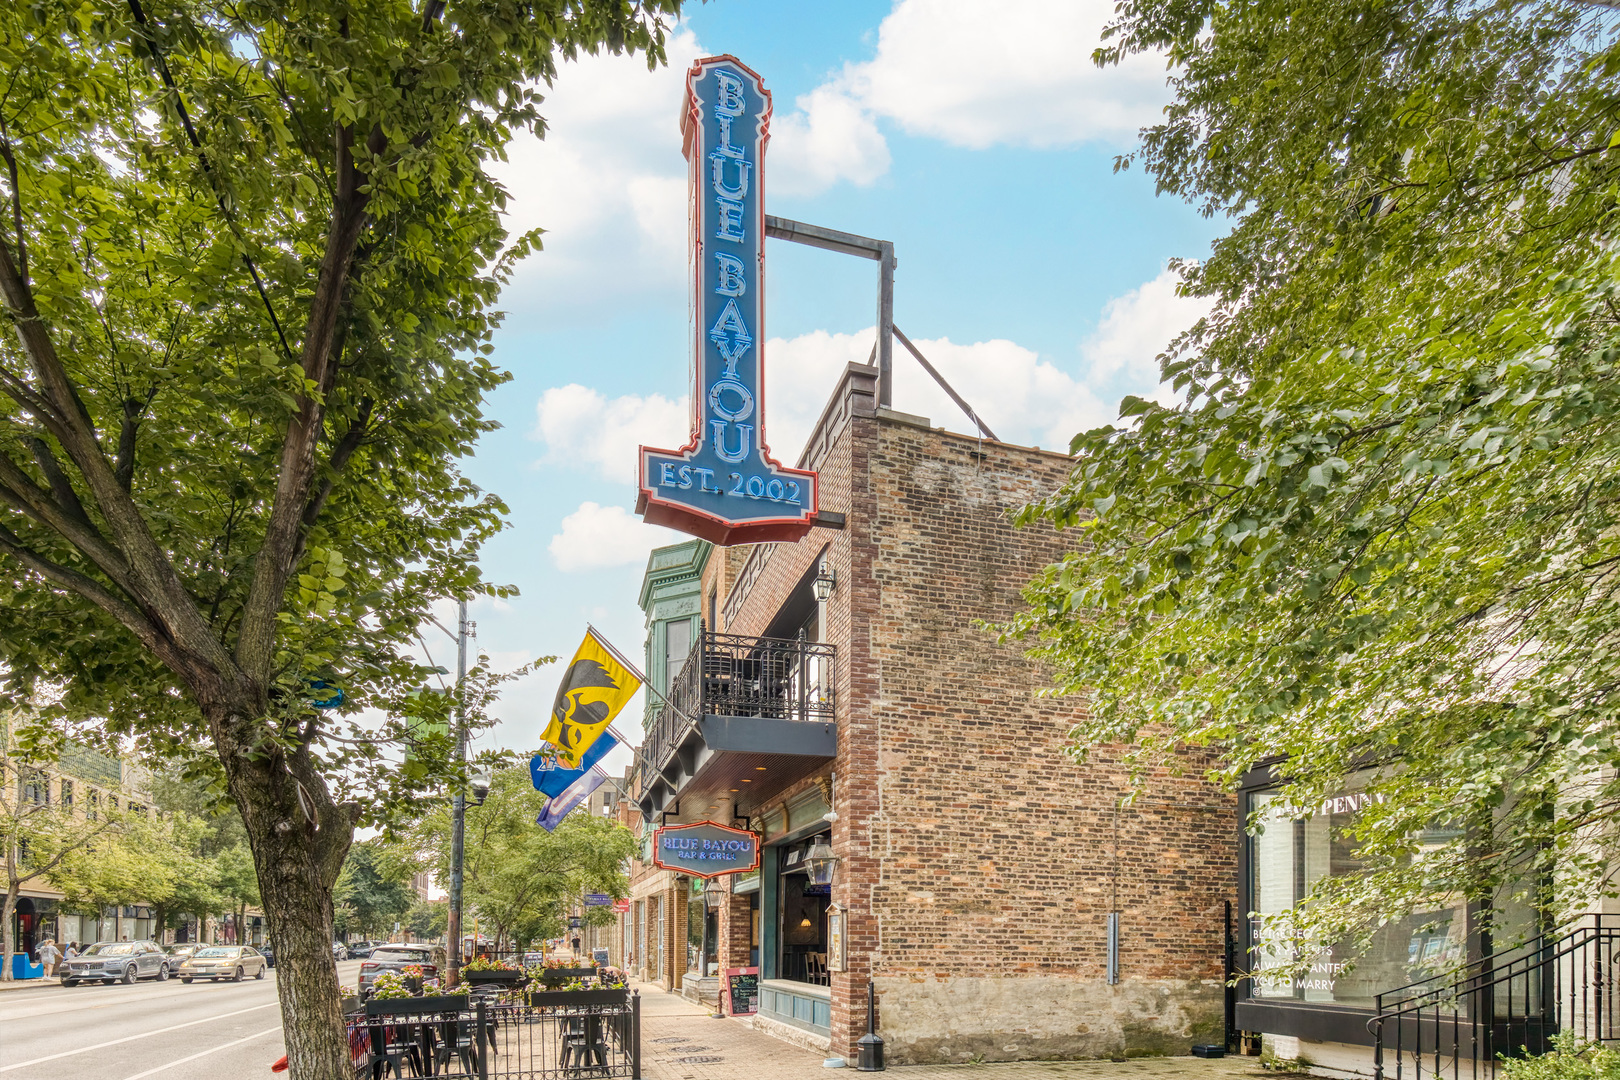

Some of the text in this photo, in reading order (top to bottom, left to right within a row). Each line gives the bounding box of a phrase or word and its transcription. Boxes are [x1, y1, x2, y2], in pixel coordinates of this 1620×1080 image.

[708, 69, 754, 463] BLUE BAYOU
[659, 462, 801, 505] EST. 2002
[1321, 792, 1386, 816] PENNY
[663, 838, 751, 852] BLUE BAYOU
[678, 850, 697, 859] BAR
[709, 852, 737, 861] GRILL
[1252, 945, 1281, 956] YOR
[1253, 961, 1294, 972] ALWAY
[1253, 976, 1275, 986] YOU
[1296, 979, 1336, 990] MARRY
